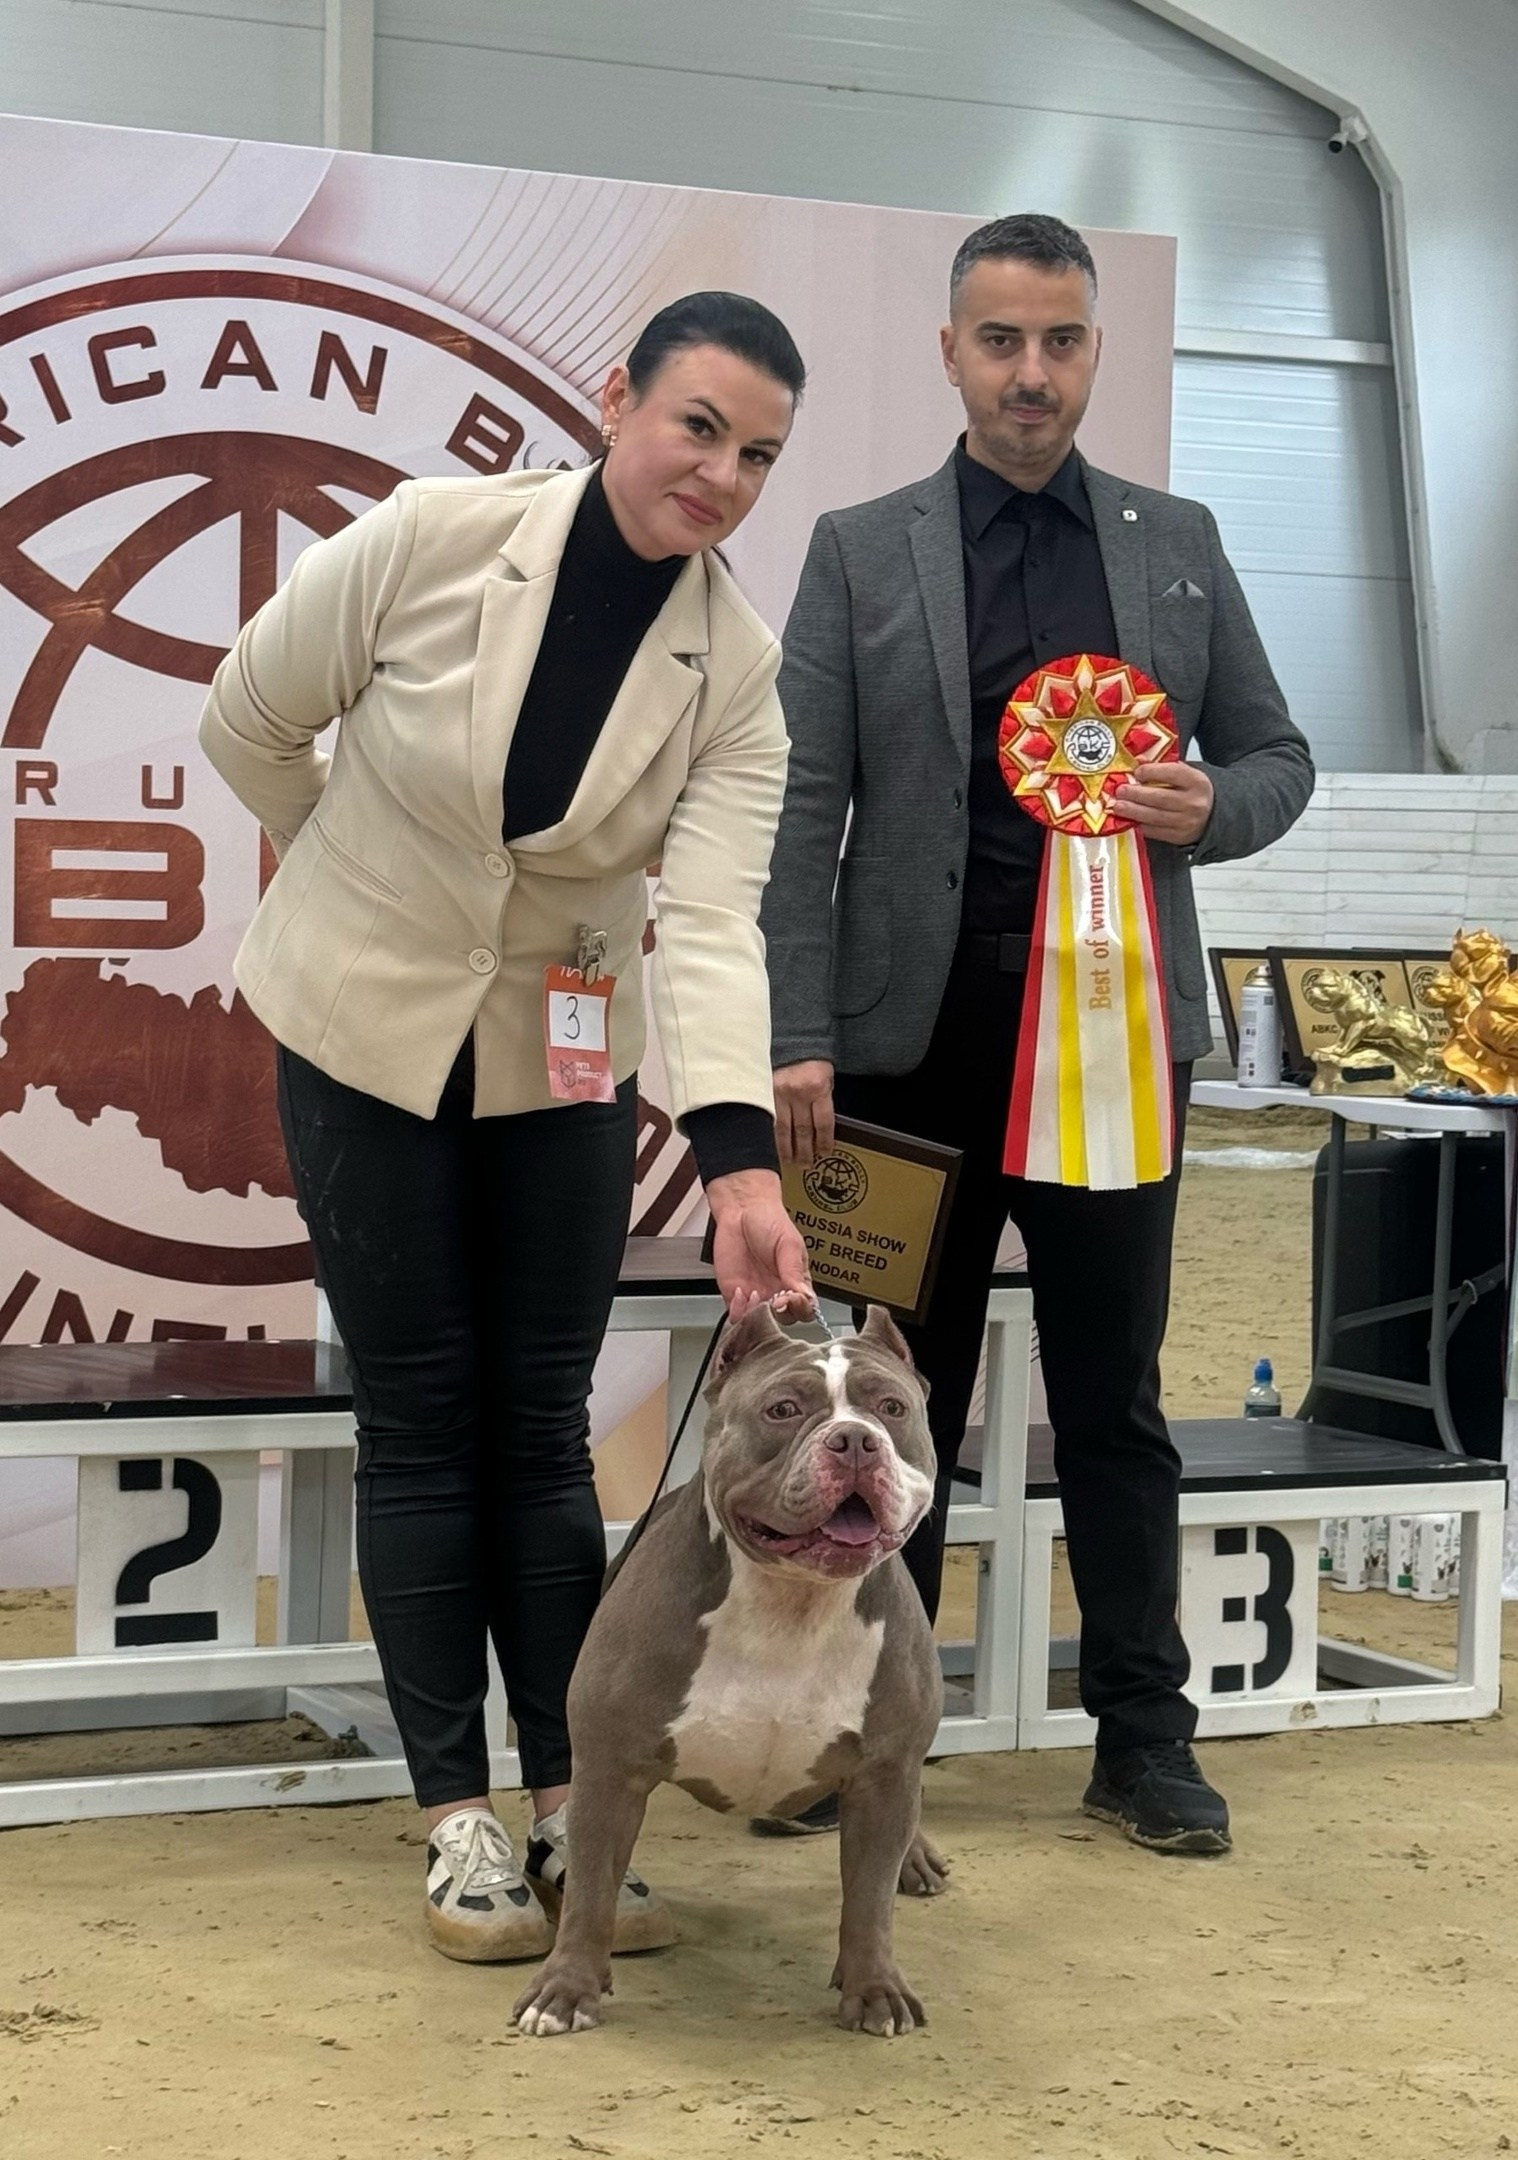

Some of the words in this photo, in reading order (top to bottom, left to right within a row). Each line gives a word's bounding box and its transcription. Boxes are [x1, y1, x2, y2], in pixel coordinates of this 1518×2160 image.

[1087, 864, 1105, 932] winner
[1085, 937, 1110, 960] of
[1089, 968, 1112, 1012] Best
[564, 995, 581, 1040] 3
[795, 1210, 852, 1239] RUSSIA
[856, 1230, 907, 1254] SHOW
[803, 1234, 826, 1252] OF
[829, 1243, 887, 1271] BREED
[114, 1457, 222, 1648] 2
[1211, 1525, 1294, 1694] 3
